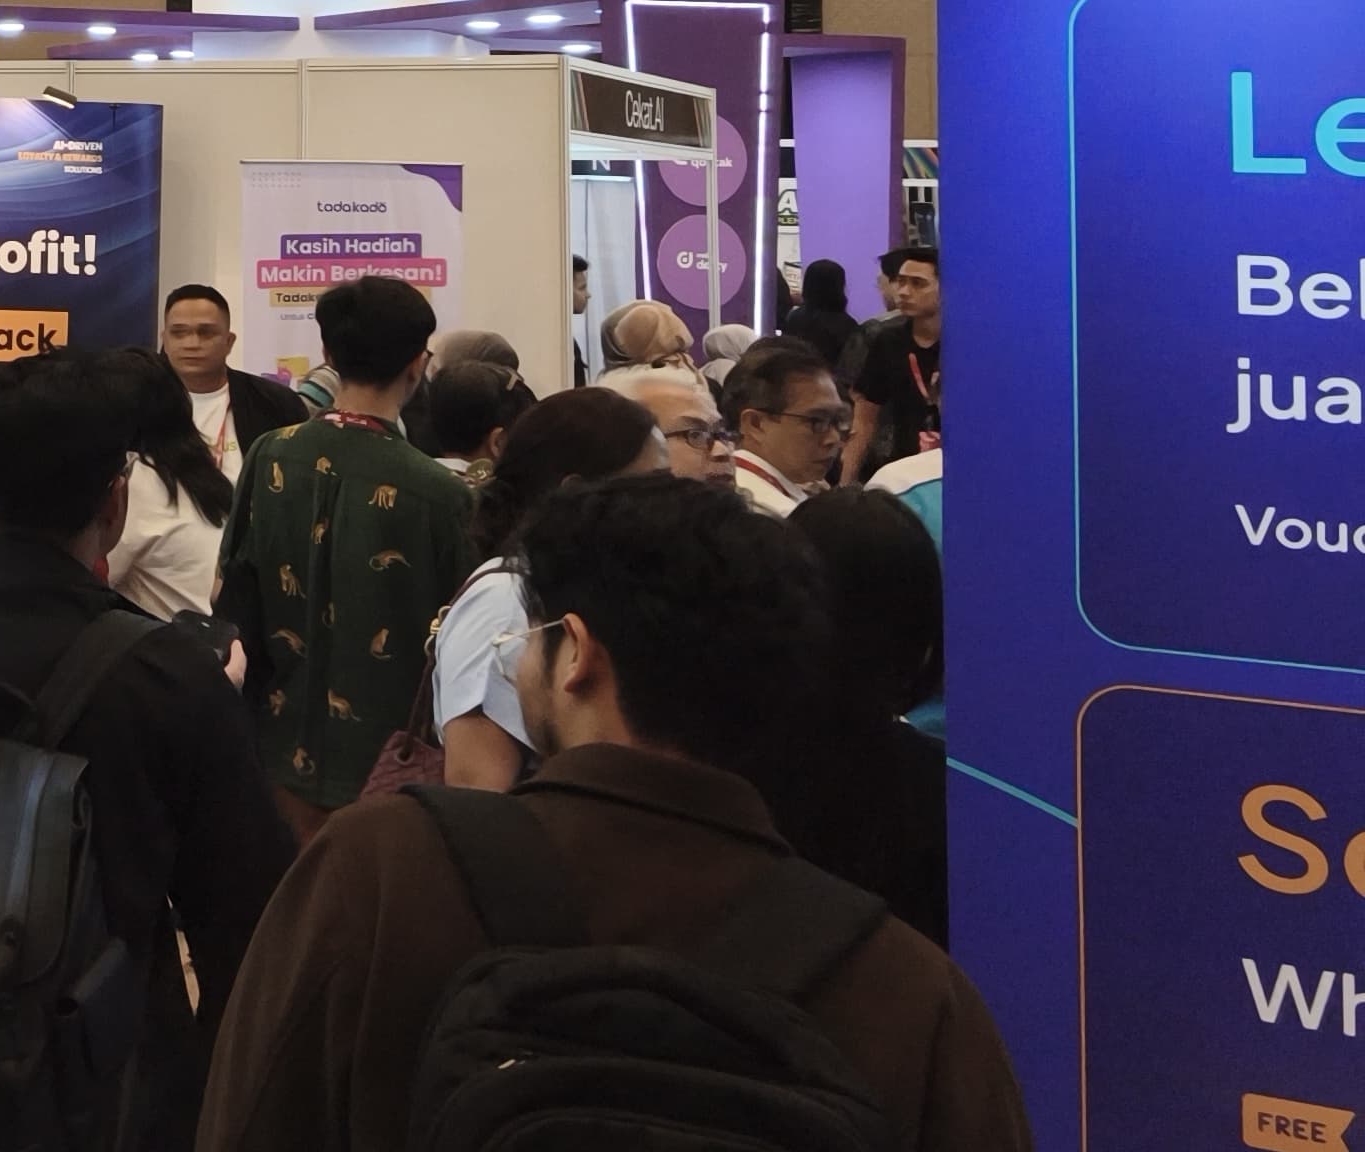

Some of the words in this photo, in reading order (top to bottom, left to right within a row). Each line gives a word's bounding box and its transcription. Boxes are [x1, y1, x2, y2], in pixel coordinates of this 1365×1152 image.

[286, 239, 341, 255] Kasih
[345, 238, 416, 254] Hadiah
[260, 264, 326, 283] Makin
[1257, 1111, 1327, 1144] FREE
